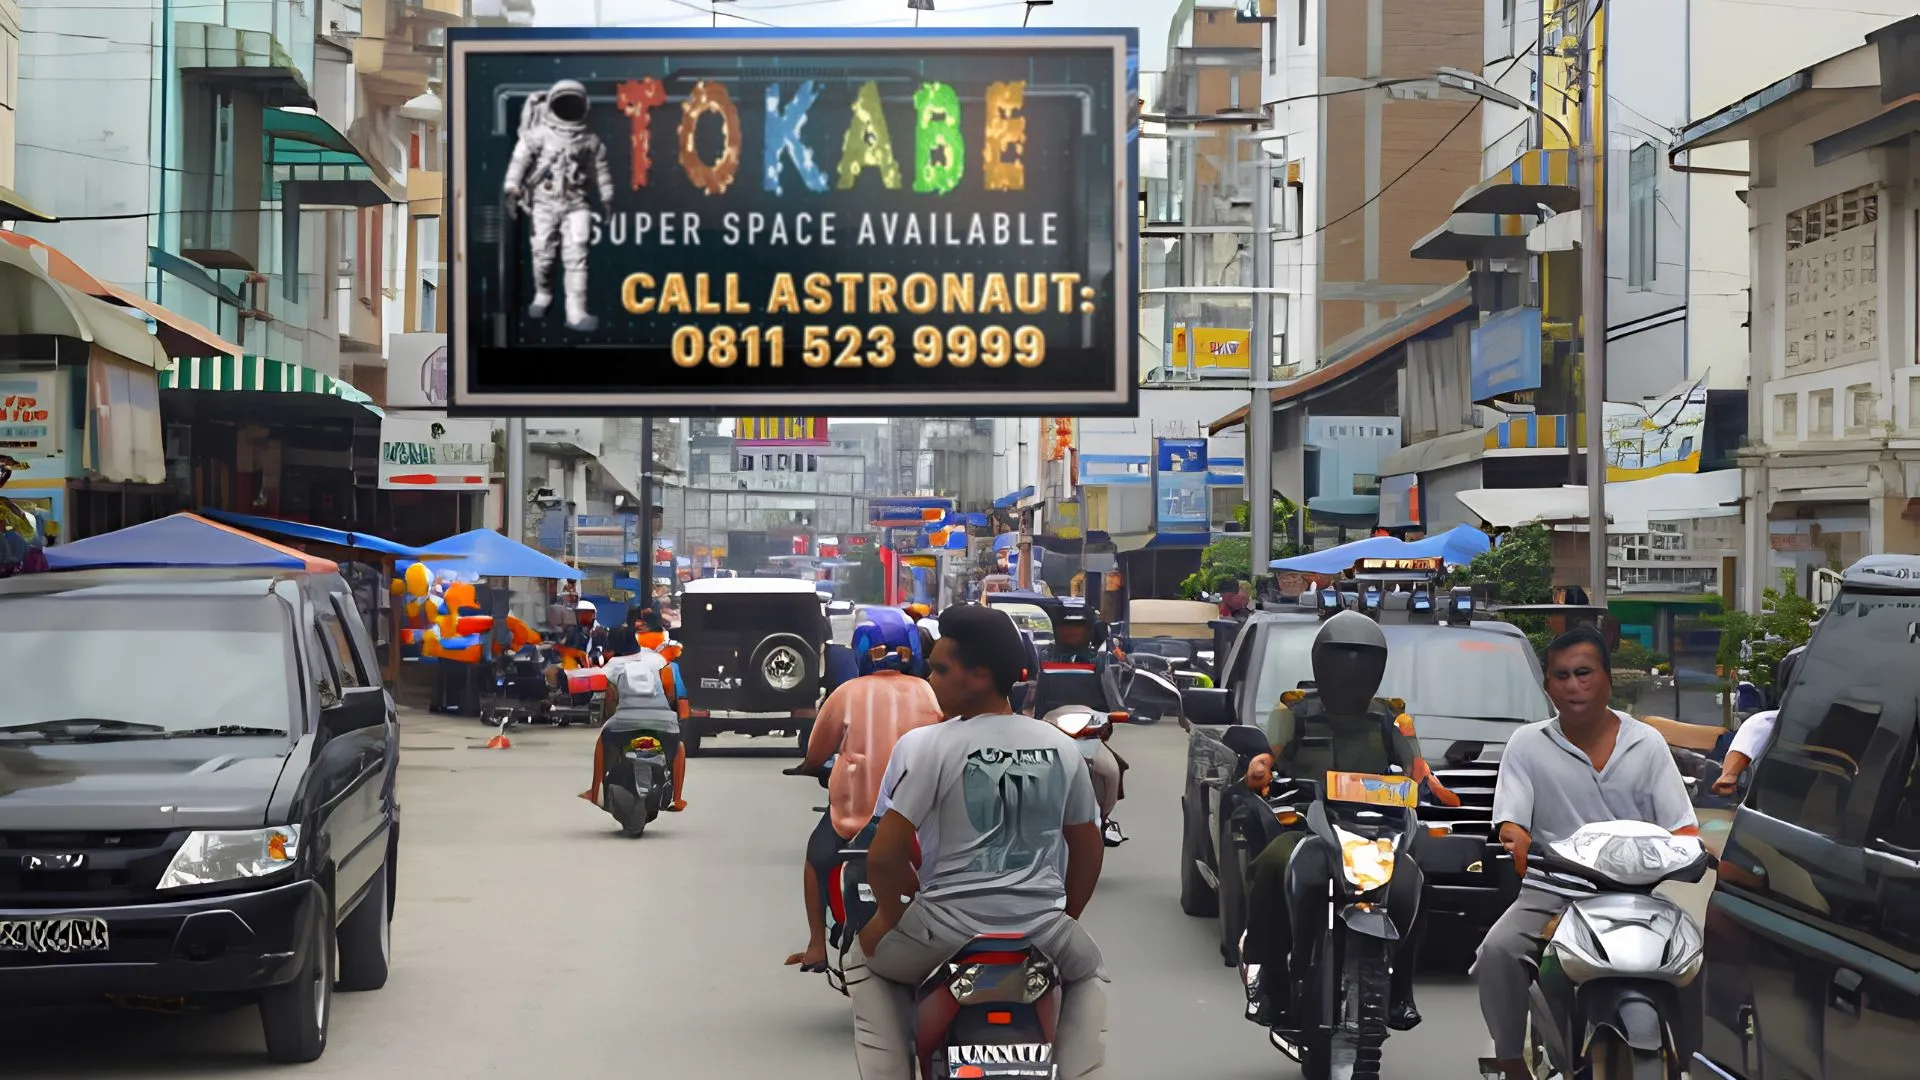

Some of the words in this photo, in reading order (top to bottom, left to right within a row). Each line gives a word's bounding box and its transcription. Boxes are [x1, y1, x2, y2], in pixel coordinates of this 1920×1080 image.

[616, 76, 1027, 194] TOKABE
[588, 212, 701, 246] SUPER
[723, 212, 838, 246] SPACE
[857, 211, 1059, 246] AVAILABLE
[621, 272, 750, 314] CALL
[767, 272, 1096, 315] ASTRONAUT:
[671, 326, 784, 368] 0811
[802, 326, 896, 368] 523
[912, 326, 1046, 368] 9999
